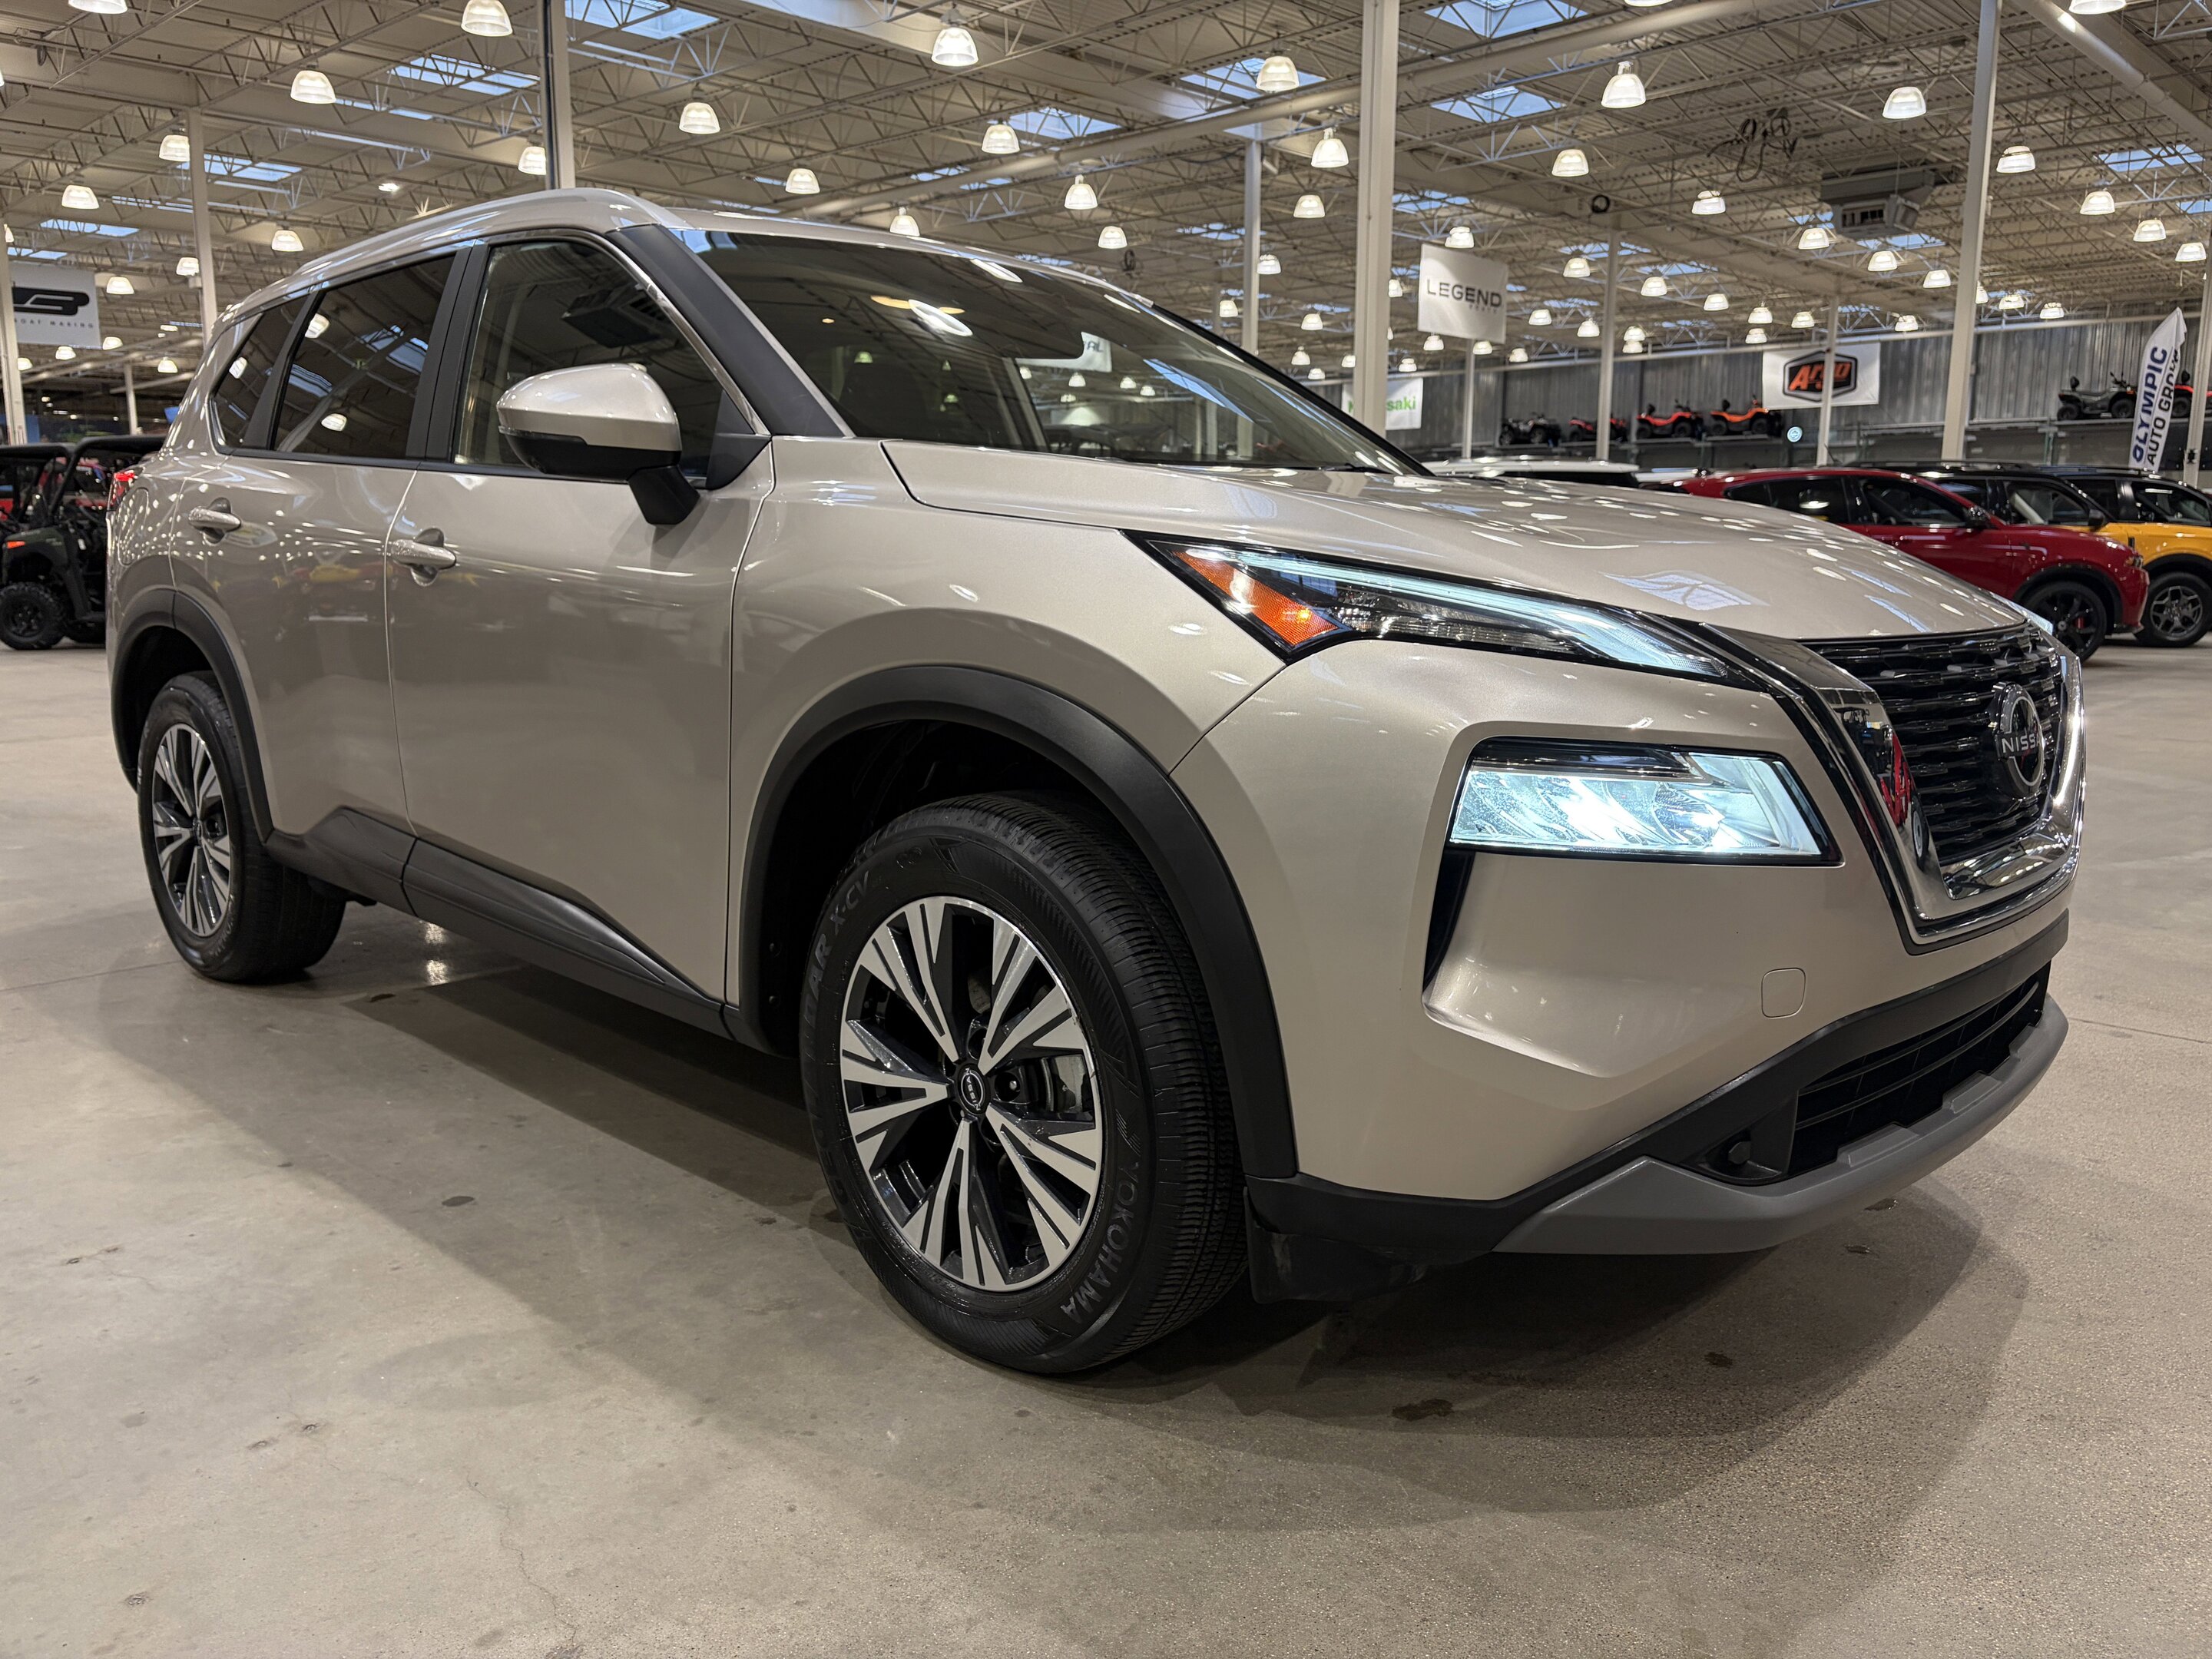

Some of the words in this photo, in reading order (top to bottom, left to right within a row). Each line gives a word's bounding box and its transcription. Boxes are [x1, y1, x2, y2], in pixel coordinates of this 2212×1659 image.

[1426, 278, 1503, 308] LEGEND
[2132, 346, 2167, 462] OLYMPIC
[2147, 417, 2167, 467] AUTO
[2001, 733, 2041, 753] NISSA
[1059, 1161, 1139, 1324] YOKOHAMA
